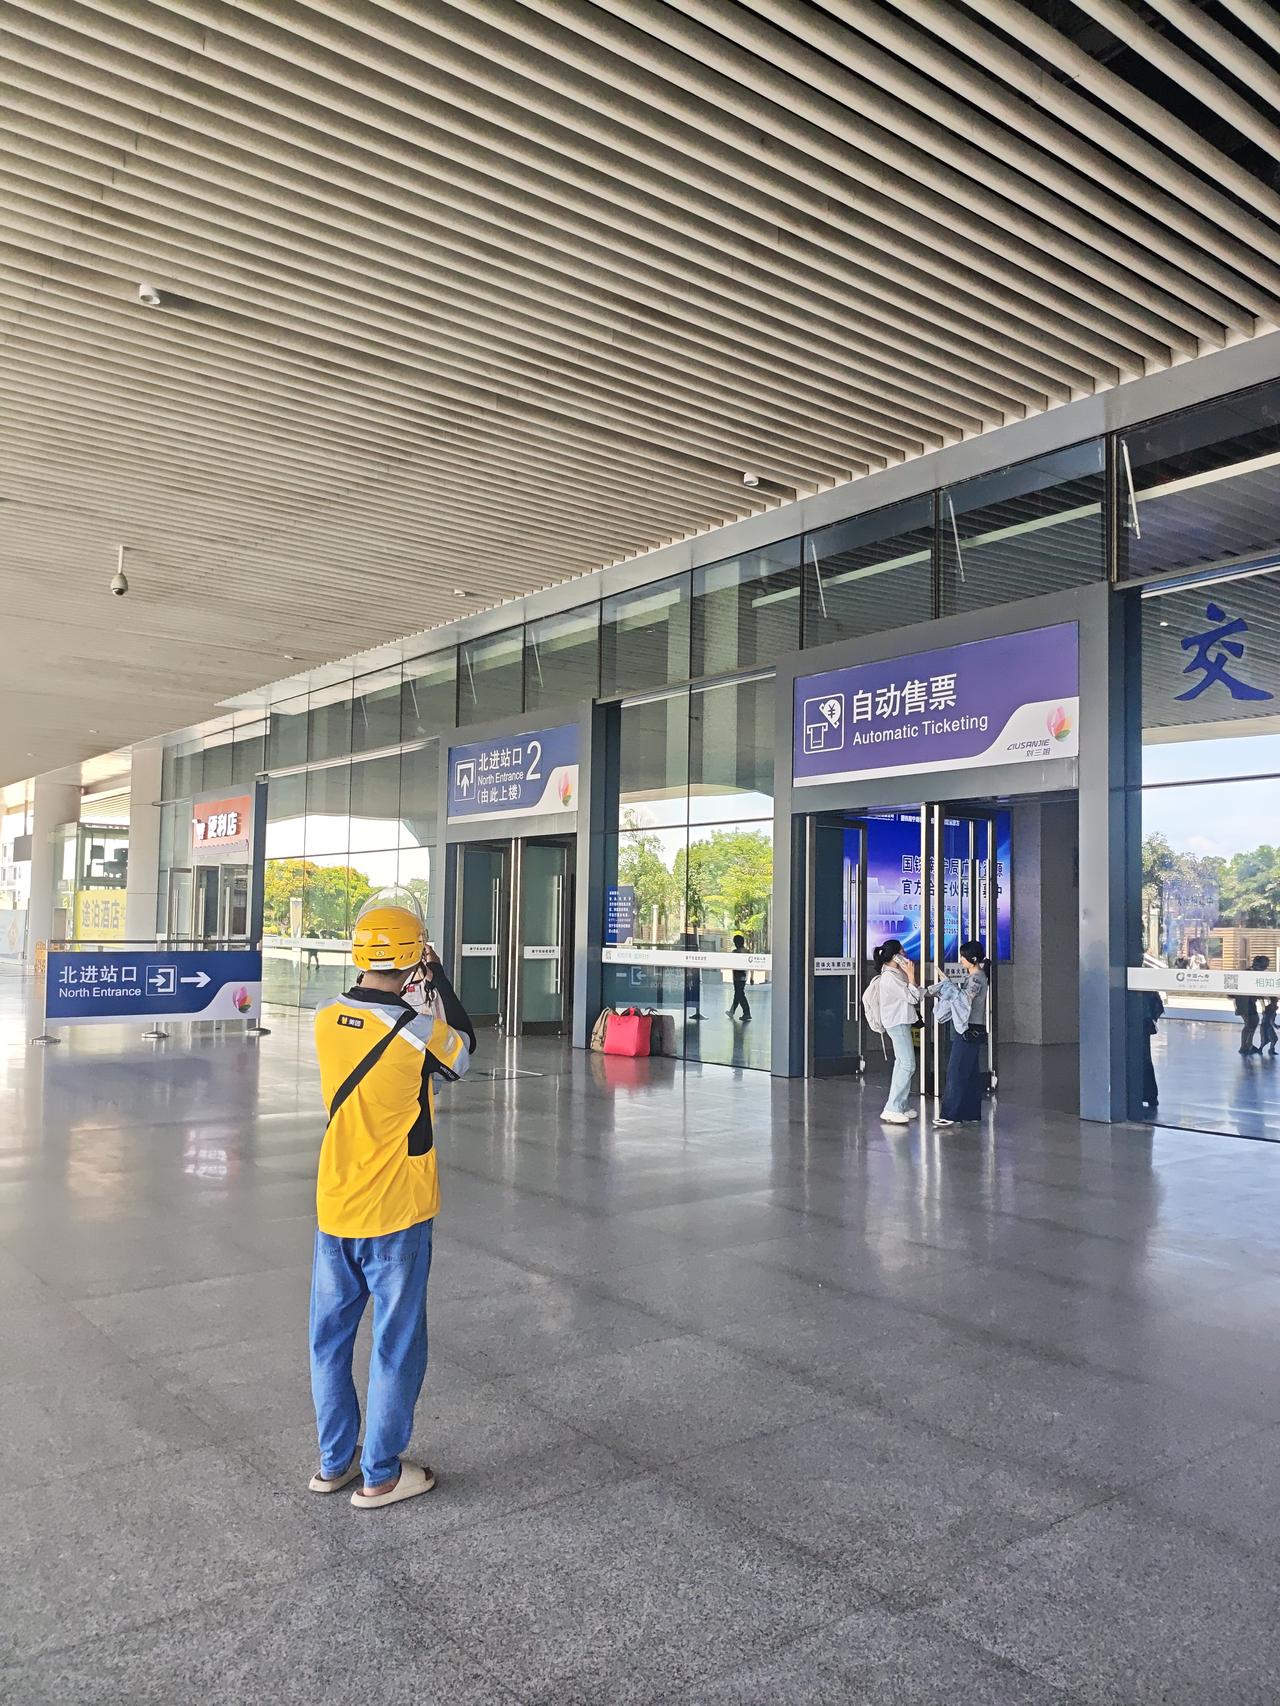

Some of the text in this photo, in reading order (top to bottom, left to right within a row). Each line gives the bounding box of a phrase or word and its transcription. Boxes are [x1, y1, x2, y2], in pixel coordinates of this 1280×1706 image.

[1174, 603, 1274, 700] 交
[852, 673, 957, 724] 自动售票
[853, 715, 988, 745] Automatic Ticketing
[478, 741, 542, 780] 北进站口 2
[477, 770, 524, 786] North Entrance
[207, 811, 238, 839] 便利店
[58, 964, 138, 984] 北进站口
[59, 987, 142, 998] North Entrance
